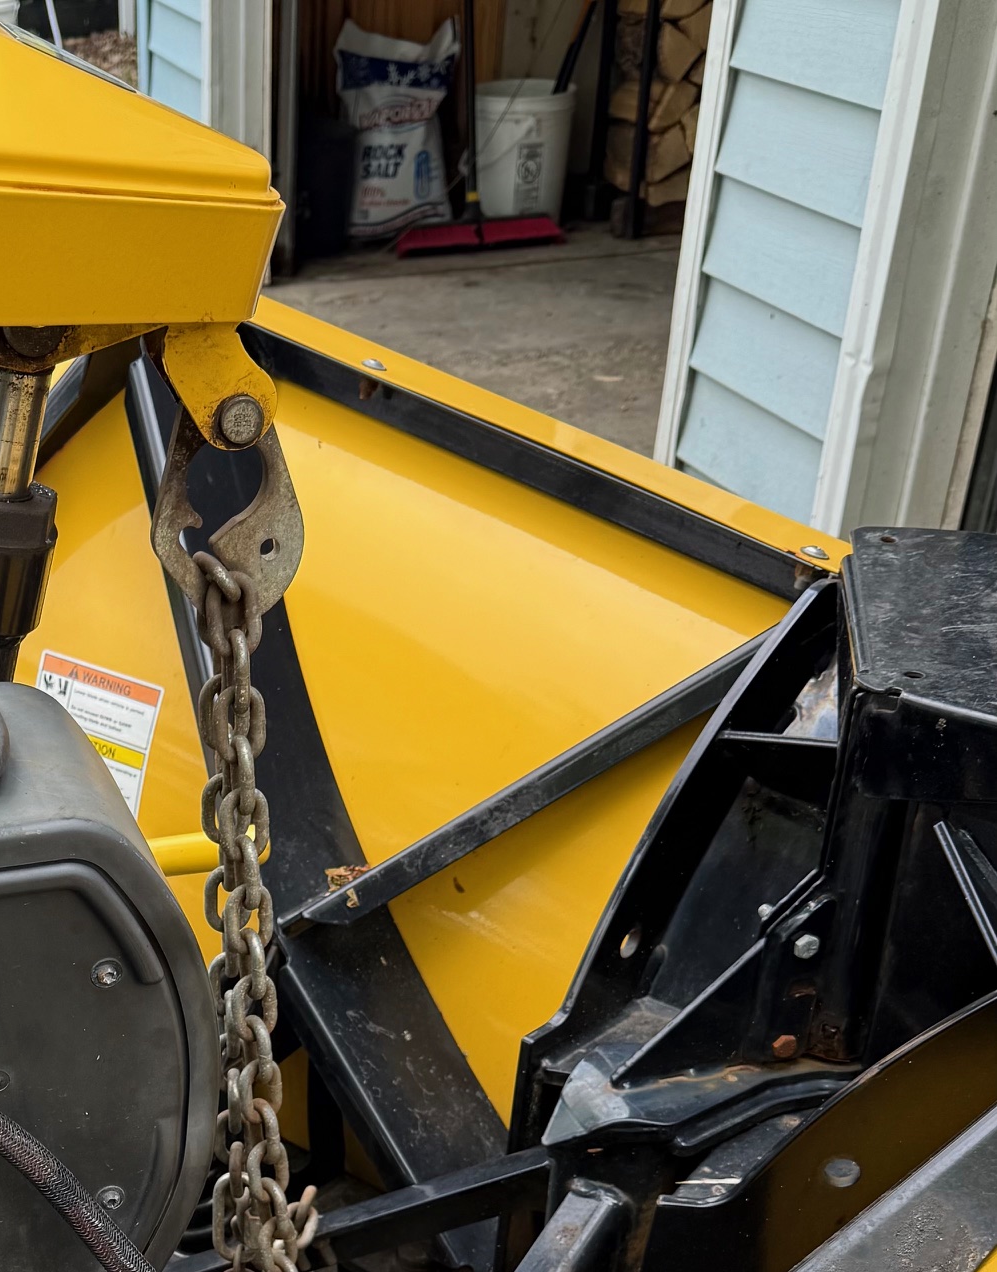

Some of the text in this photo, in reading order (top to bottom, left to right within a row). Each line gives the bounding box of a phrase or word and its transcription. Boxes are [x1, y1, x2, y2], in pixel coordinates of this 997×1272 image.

[361, 143, 408, 161] ROCK
[361, 162, 402, 180] SALT
[82, 671, 131, 697] WARNING
